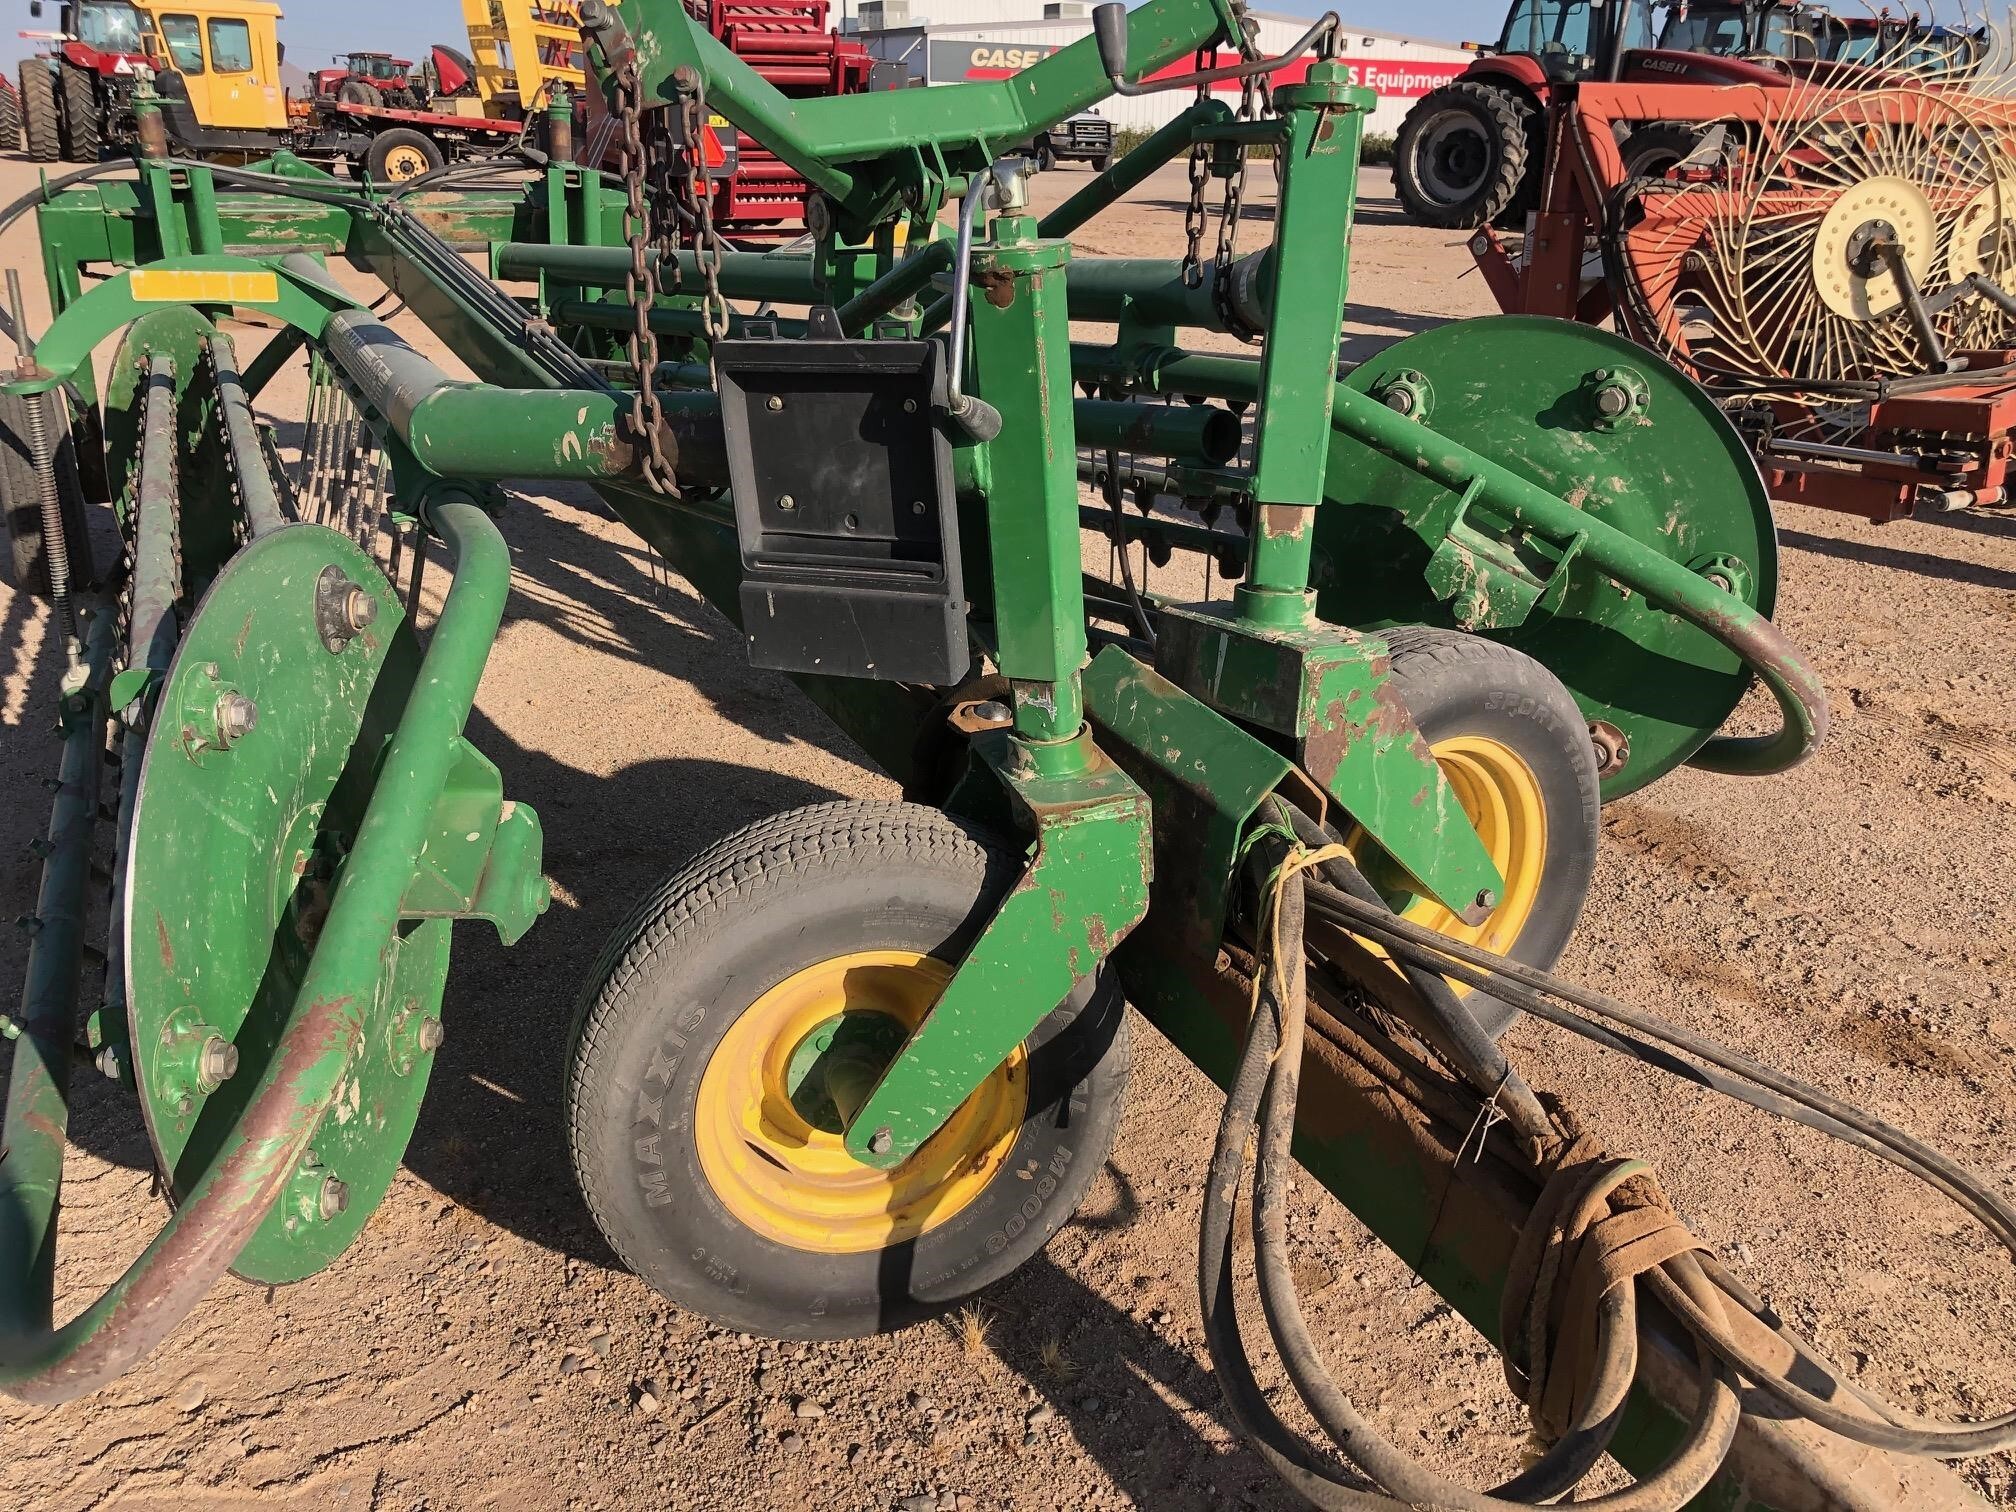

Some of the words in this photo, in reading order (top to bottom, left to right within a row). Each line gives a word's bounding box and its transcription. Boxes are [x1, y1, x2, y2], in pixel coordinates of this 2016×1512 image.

[970, 48, 1040, 69] CASE
[1365, 67, 1459, 94] Equipmen
[635, 1006, 708, 1208] MAXXIS
[984, 1144, 1073, 1255] M8008
